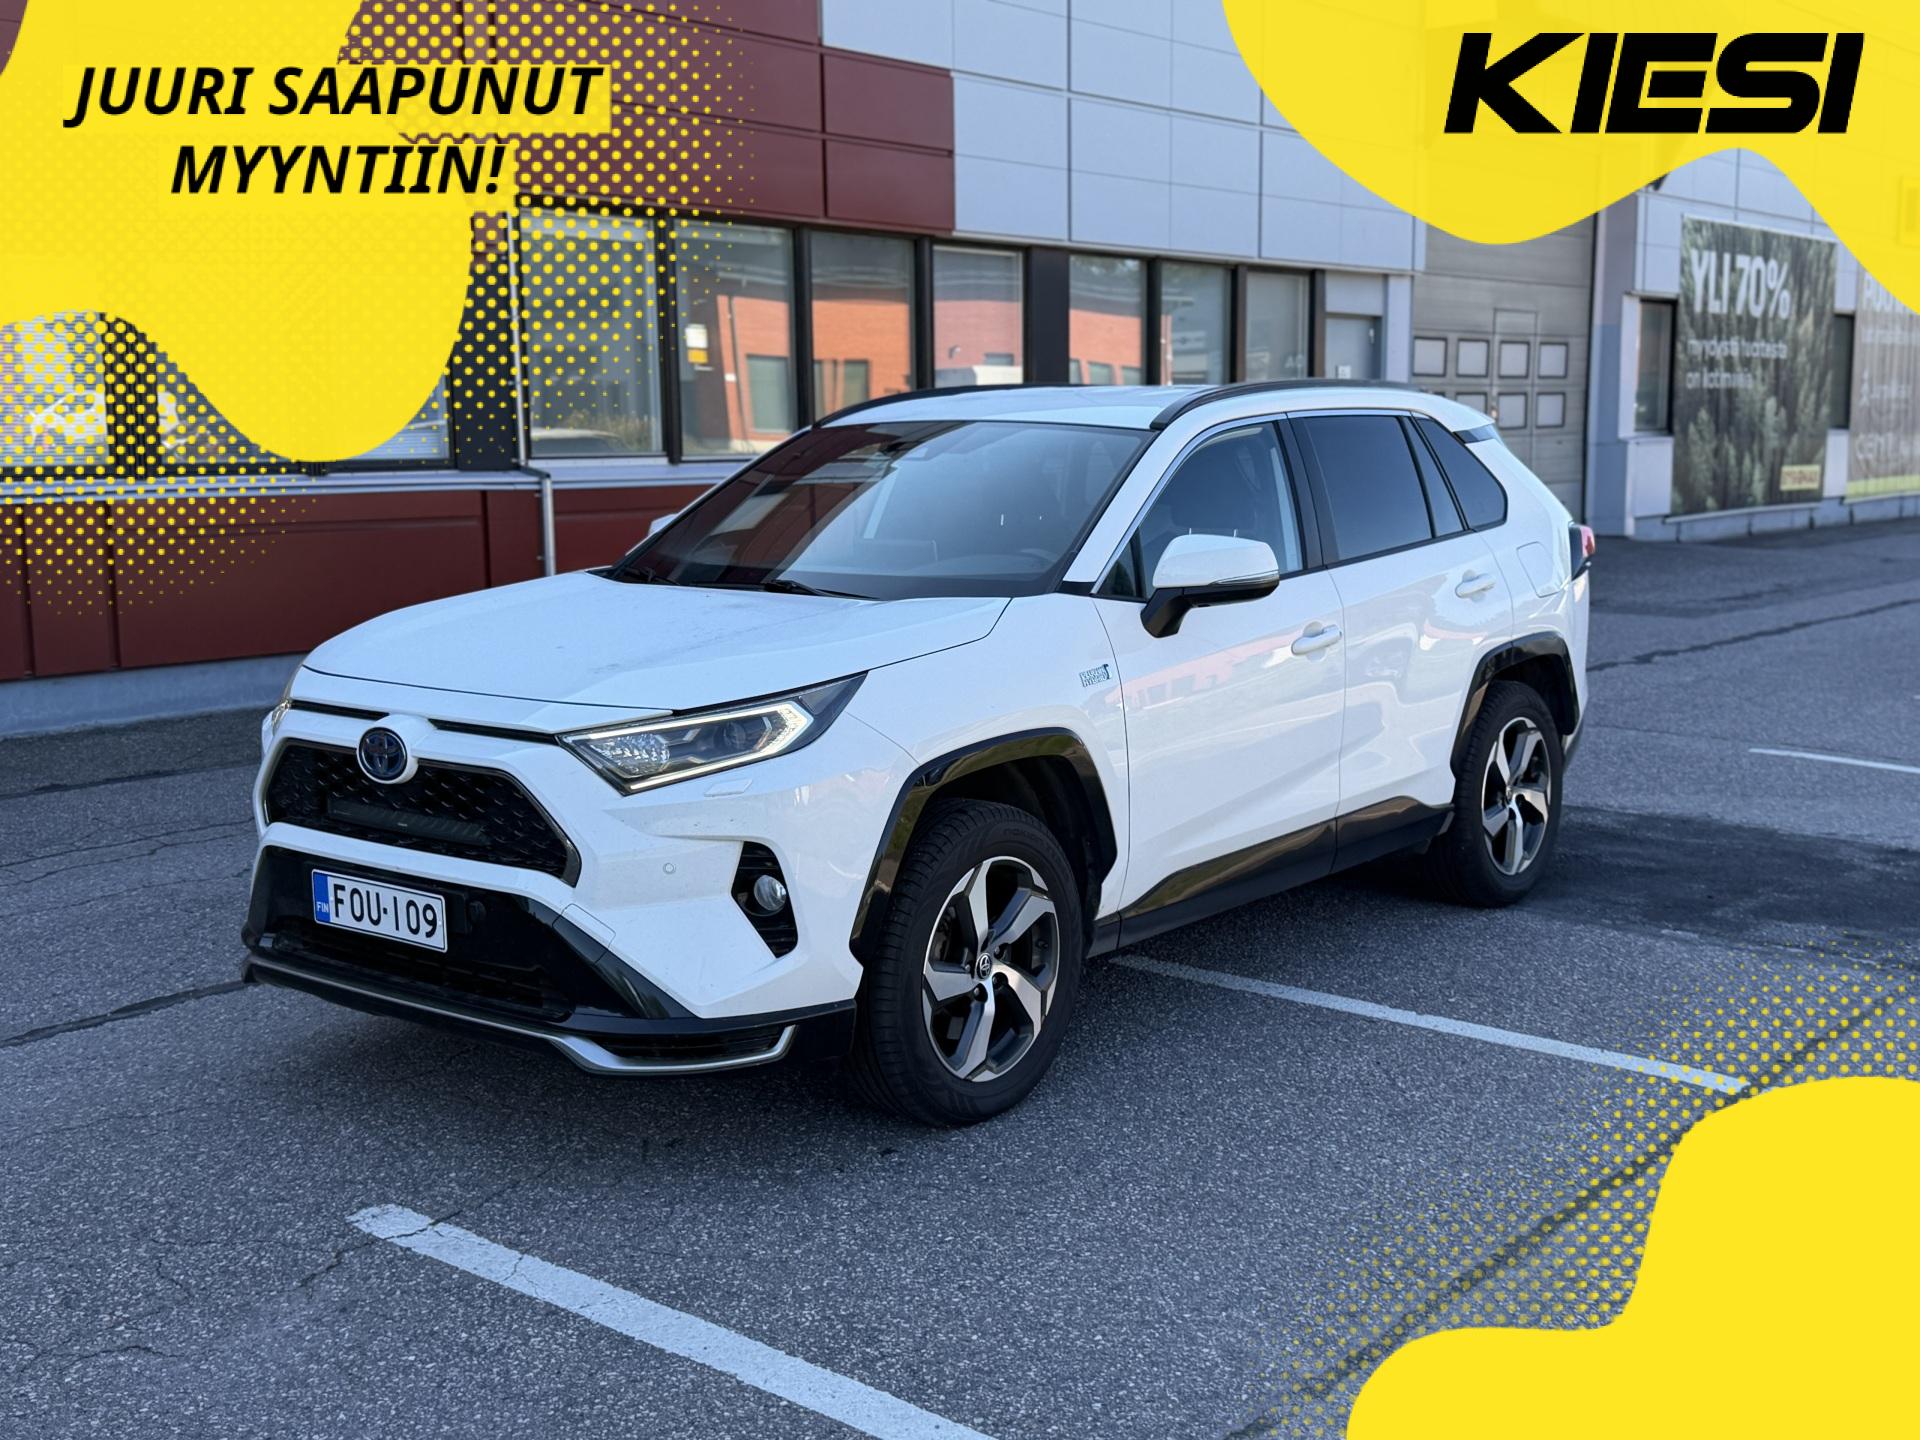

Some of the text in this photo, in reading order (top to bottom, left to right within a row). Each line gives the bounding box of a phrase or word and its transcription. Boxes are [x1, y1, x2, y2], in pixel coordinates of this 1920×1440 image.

[1690, 247, 1730, 315] YLI
[1735, 253, 1792, 319] 70%
[316, 901, 330, 913] FIN
[333, 883, 438, 938] FOU-109
